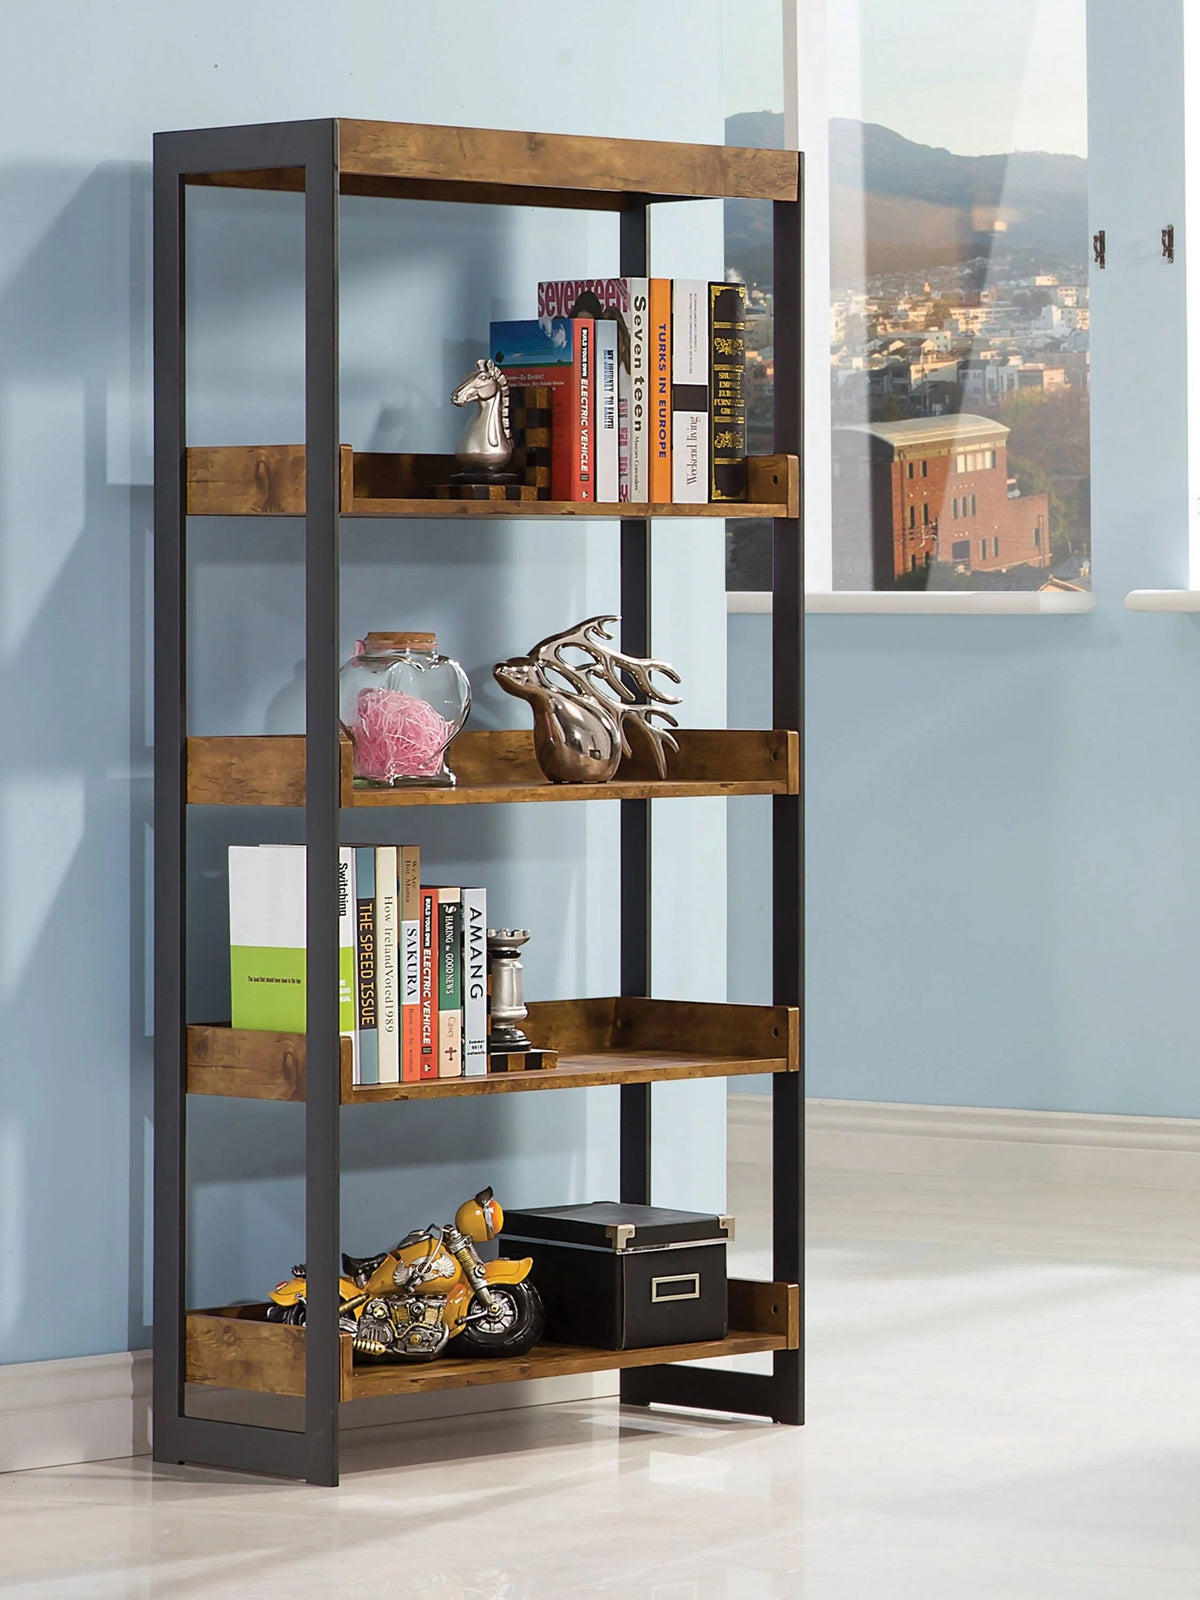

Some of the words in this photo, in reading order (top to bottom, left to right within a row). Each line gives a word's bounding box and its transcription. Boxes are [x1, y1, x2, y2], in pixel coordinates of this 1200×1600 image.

[658, 323, 667, 372] TURKS
[580, 378, 589, 428] ELECTRIC
[603, 395, 614, 405] TO
[658, 376, 667, 394] IN
[580, 429, 589, 472] VEHICLE
[658, 399, 667, 459] EUROPE
[686, 416, 701, 441] living
[686, 444, 698, 485] Weekend
[359, 902, 373, 932] THE
[384, 896, 393, 923] How
[360, 934, 374, 979] SPEED
[406, 928, 417, 996] SAKURA
[422, 948, 432, 1000] ELECTRIC
[469, 907, 484, 999] AMANG
[360, 981, 375, 1026] ISSUE
[422, 1001, 431, 1045] VEHICLE
[447, 1016, 457, 1039] Casey
